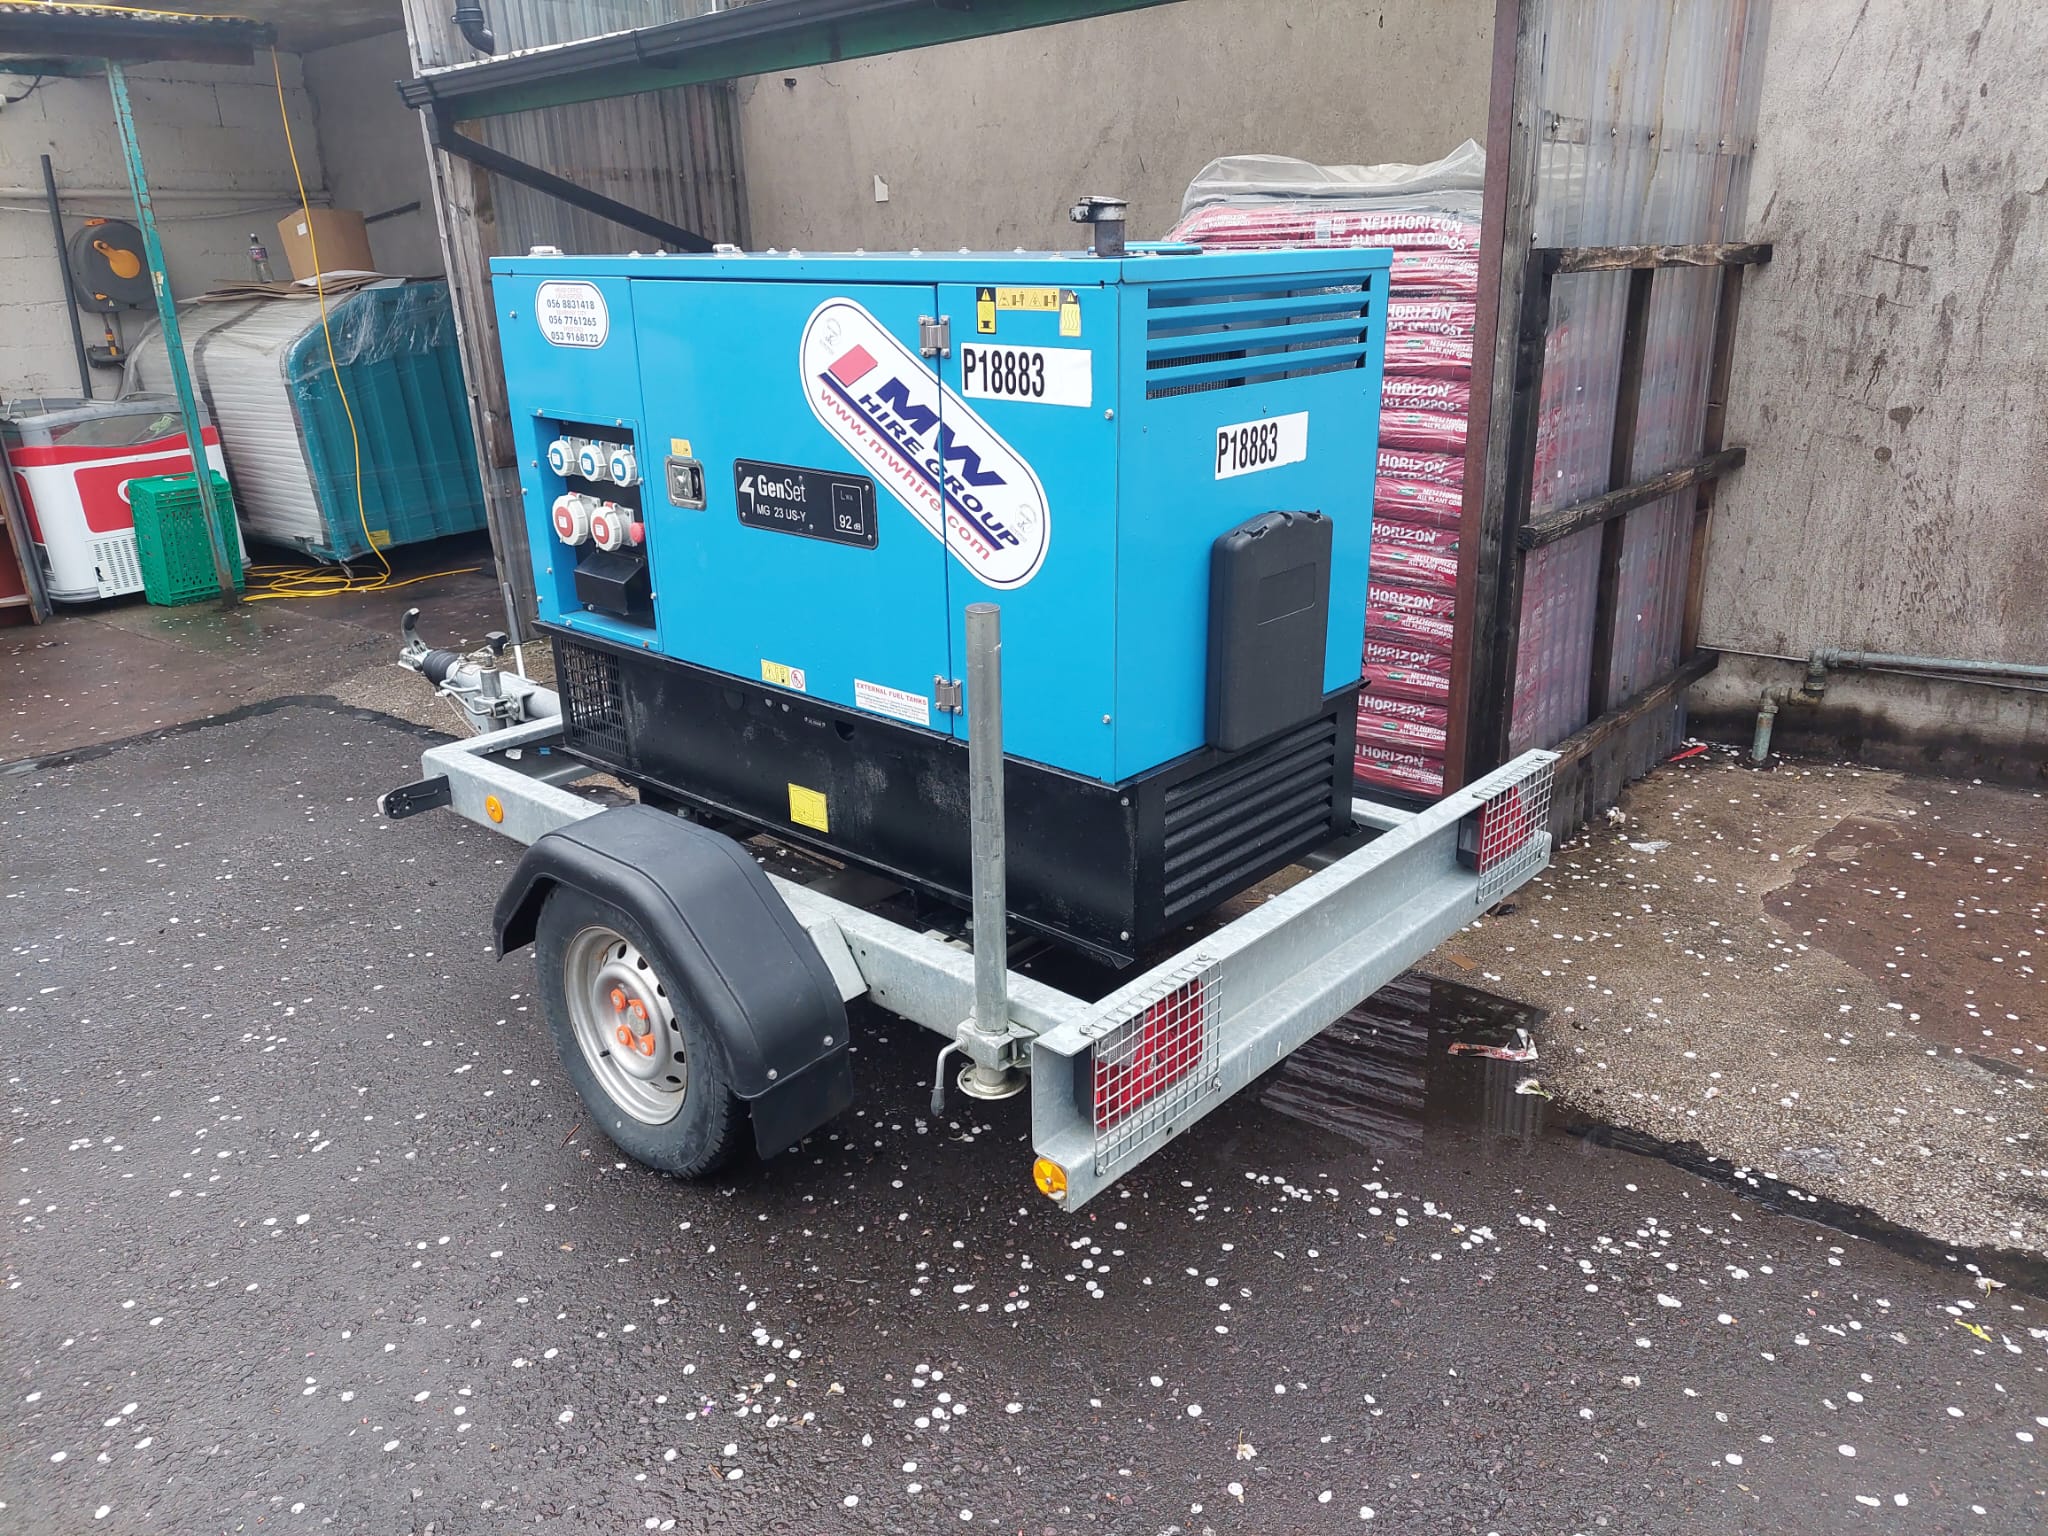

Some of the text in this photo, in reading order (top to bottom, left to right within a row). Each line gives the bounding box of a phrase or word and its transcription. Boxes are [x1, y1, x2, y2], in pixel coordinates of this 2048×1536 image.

[1395, 215, 1463, 233] HORIZON
[1374, 233, 1412, 246] PLANT
[1417, 233, 1467, 250] COMPOS
[546, 299, 595, 310] 056 8831418
[1388, 304, 1453, 320] HORIZON
[548, 315, 597, 326] 056 7761265
[551, 331, 599, 343] 053 9168122
[963, 348, 1045, 397] P18883
[1381, 381, 1450, 397] HORIZON
[875, 377, 1008, 488] MW
[1217, 422, 1278, 473] P18883
[858, 393, 1020, 547] HIRE GROUP
[1379, 453, 1447, 473] HORIZON
[820, 388, 991, 561] www.mwhire.com
[757, 474, 807, 502] GenSet
[756, 503, 807, 522] MG 23 US-Y
[839, 515, 861, 531] 92 dB
[1372, 522, 1437, 544] HORIZON
[1370, 587, 1434, 610] HORIZON
[1367, 643, 1431, 665] HORIZON
[856, 682, 928, 706] EXTERNAL FUEL TANKS
[1364, 695, 1427, 718] HORIZON
[1362, 744, 1424, 767] HORIZON
